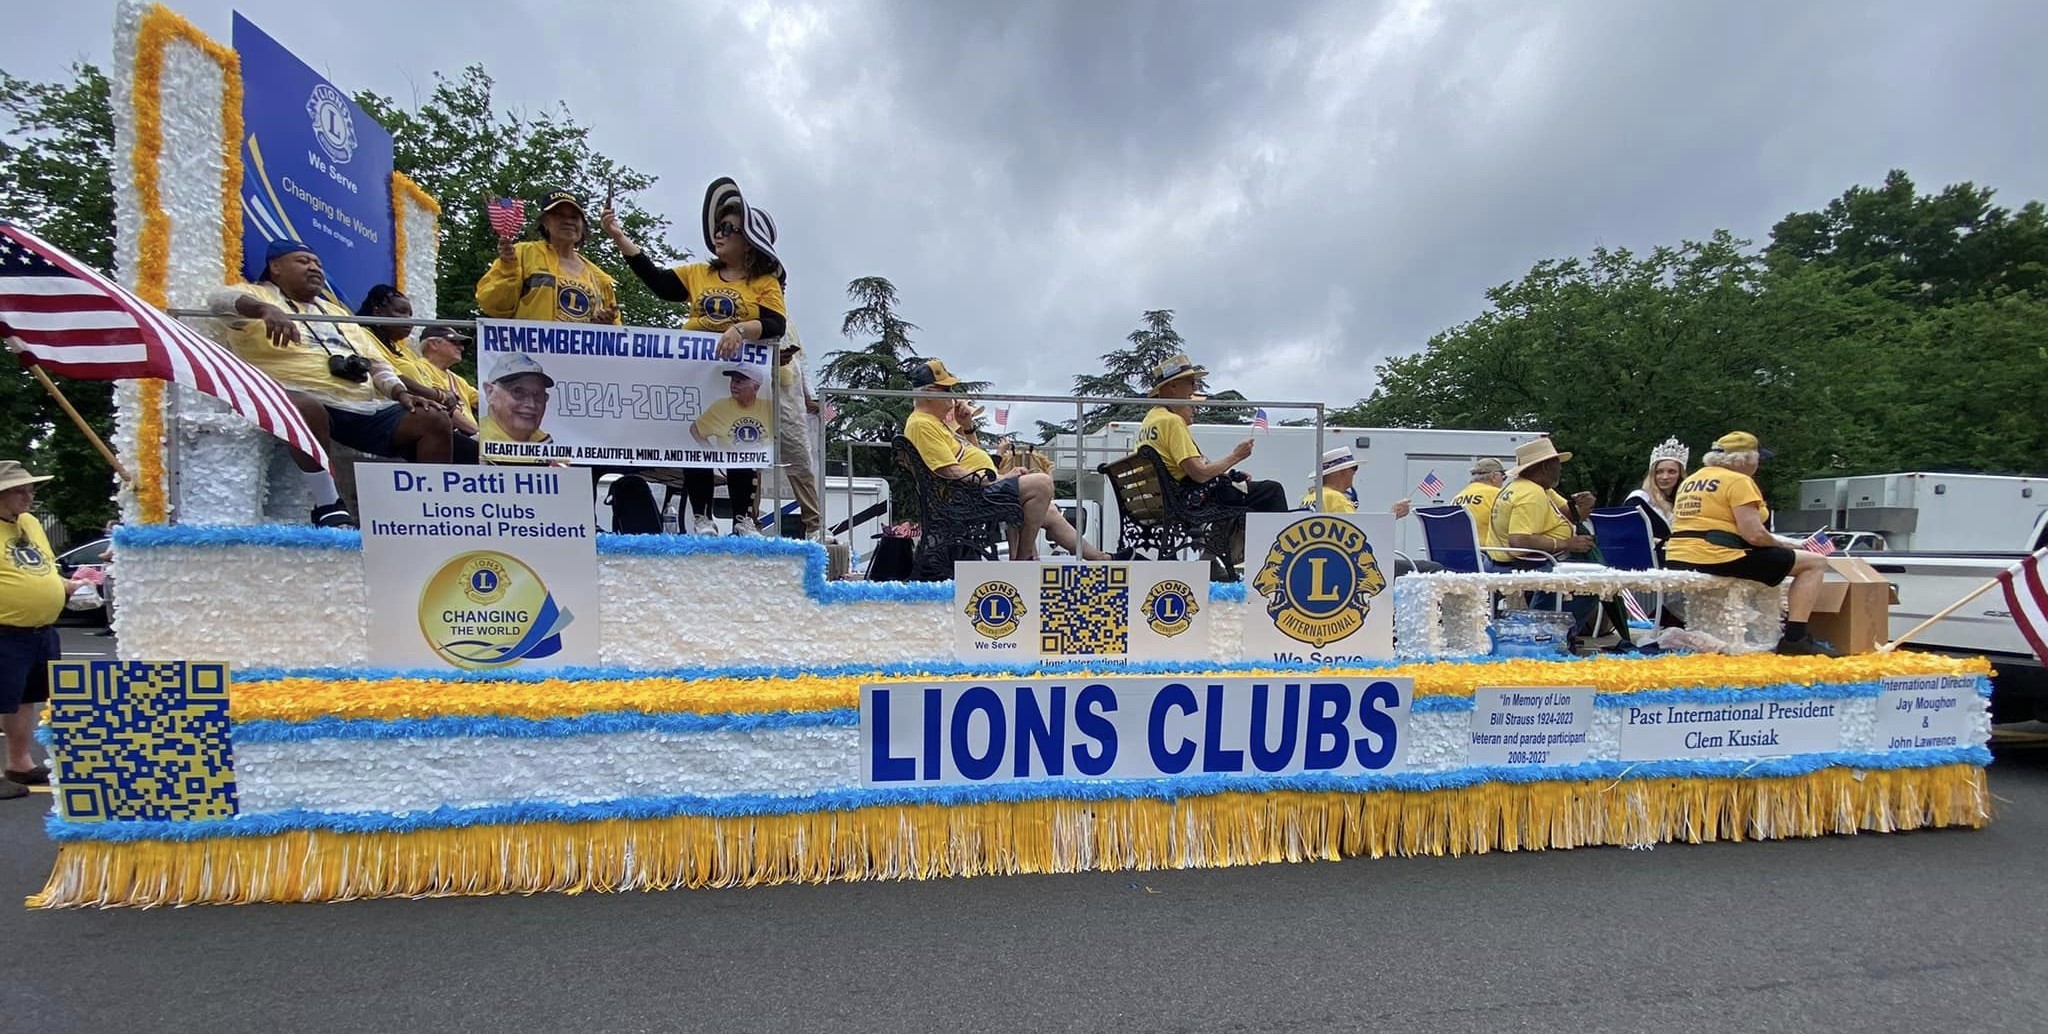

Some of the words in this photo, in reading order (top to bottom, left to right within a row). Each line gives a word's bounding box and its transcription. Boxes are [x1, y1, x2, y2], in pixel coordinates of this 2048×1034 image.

[328, 108, 341, 139] L
[308, 149, 327, 173] We
[329, 165, 358, 194] Serve
[282, 176, 334, 220] Changing
[336, 208, 351, 227] the
[353, 218, 378, 244] World
[568, 292, 583, 312] L
[484, 325, 629, 357] REMEMBERING
[632, 333, 674, 359] BILL
[556, 381, 702, 421] 1924-2023
[485, 442, 518, 456] HEART
[520, 444, 541, 457] LIKE
[542, 445, 549, 457] A
[576, 447, 584, 458] A
[585, 447, 635, 460] BEAUTIFUL
[664, 449, 684, 461] AND
[685, 450, 702, 462] THE
[703, 450, 725, 463] WILL
[726, 451, 740, 463] TO
[740, 452, 770, 463] SERVE.
[394, 470, 432, 492] Dr.
[443, 471, 504, 494] Patti
[515, 473, 559, 494] Hill
[1680, 479, 1721, 493] IONS
[1452, 494, 1483, 506] IONS
[422, 502, 475, 518] Lions
[481, 503, 535, 519] Clubs
[372, 520, 491, 536] International
[498, 521, 586, 538] President
[1284, 521, 1360, 549] LIONS
[479, 572, 493, 589] L
[1307, 557, 1340, 601] L
[978, 583, 1015, 596] LIONS
[1154, 582, 1187, 595] LIONS
[989, 599, 1005, 619] L
[1163, 598, 1178, 617] L
[442, 610, 529, 623] CHANGING
[1282, 613, 1357, 637] INTERNATIONAL
[451, 626, 473, 635] THE
[476, 626, 520, 636] WORLD
[975, 641, 989, 649] We
[991, 641, 1017, 649] Serve
[1274, 652, 1303, 664] We
[1310, 652, 1363, 665] Serve
[1881, 678, 1939, 691] International
[1941, 677, 1976, 689] Director
[1512, 693, 1543, 708] Memory
[1544, 693, 1554, 706] of
[1554, 693, 1571, 705] Lion
[1895, 698, 1913, 712] Jay
[1915, 697, 1956, 711] Moughon
[1490, 713, 1504, 725] Bill
[1505, 713, 1535, 725] Strauss
[1537, 712, 1574, 725] 1924-2023
[1628, 707, 1662, 724] Past
[1666, 703, 1764, 724] International
[1769, 701, 1835, 720] President
[1922, 716, 1929, 728] &
[870, 684, 1119, 782] LIONS
[1147, 681, 1401, 773] CLUBS
[1471, 732, 1501, 745] Veteran
[1503, 732, 1519, 744] and
[1520, 732, 1545, 747] parade
[1548, 732, 1586, 747] participant
[1684, 731, 1723, 749] Clem
[1727, 729, 1779, 747] Kusiak
[1888, 736, 1912, 749] John
[1914, 735, 1957, 747] Lawrence
